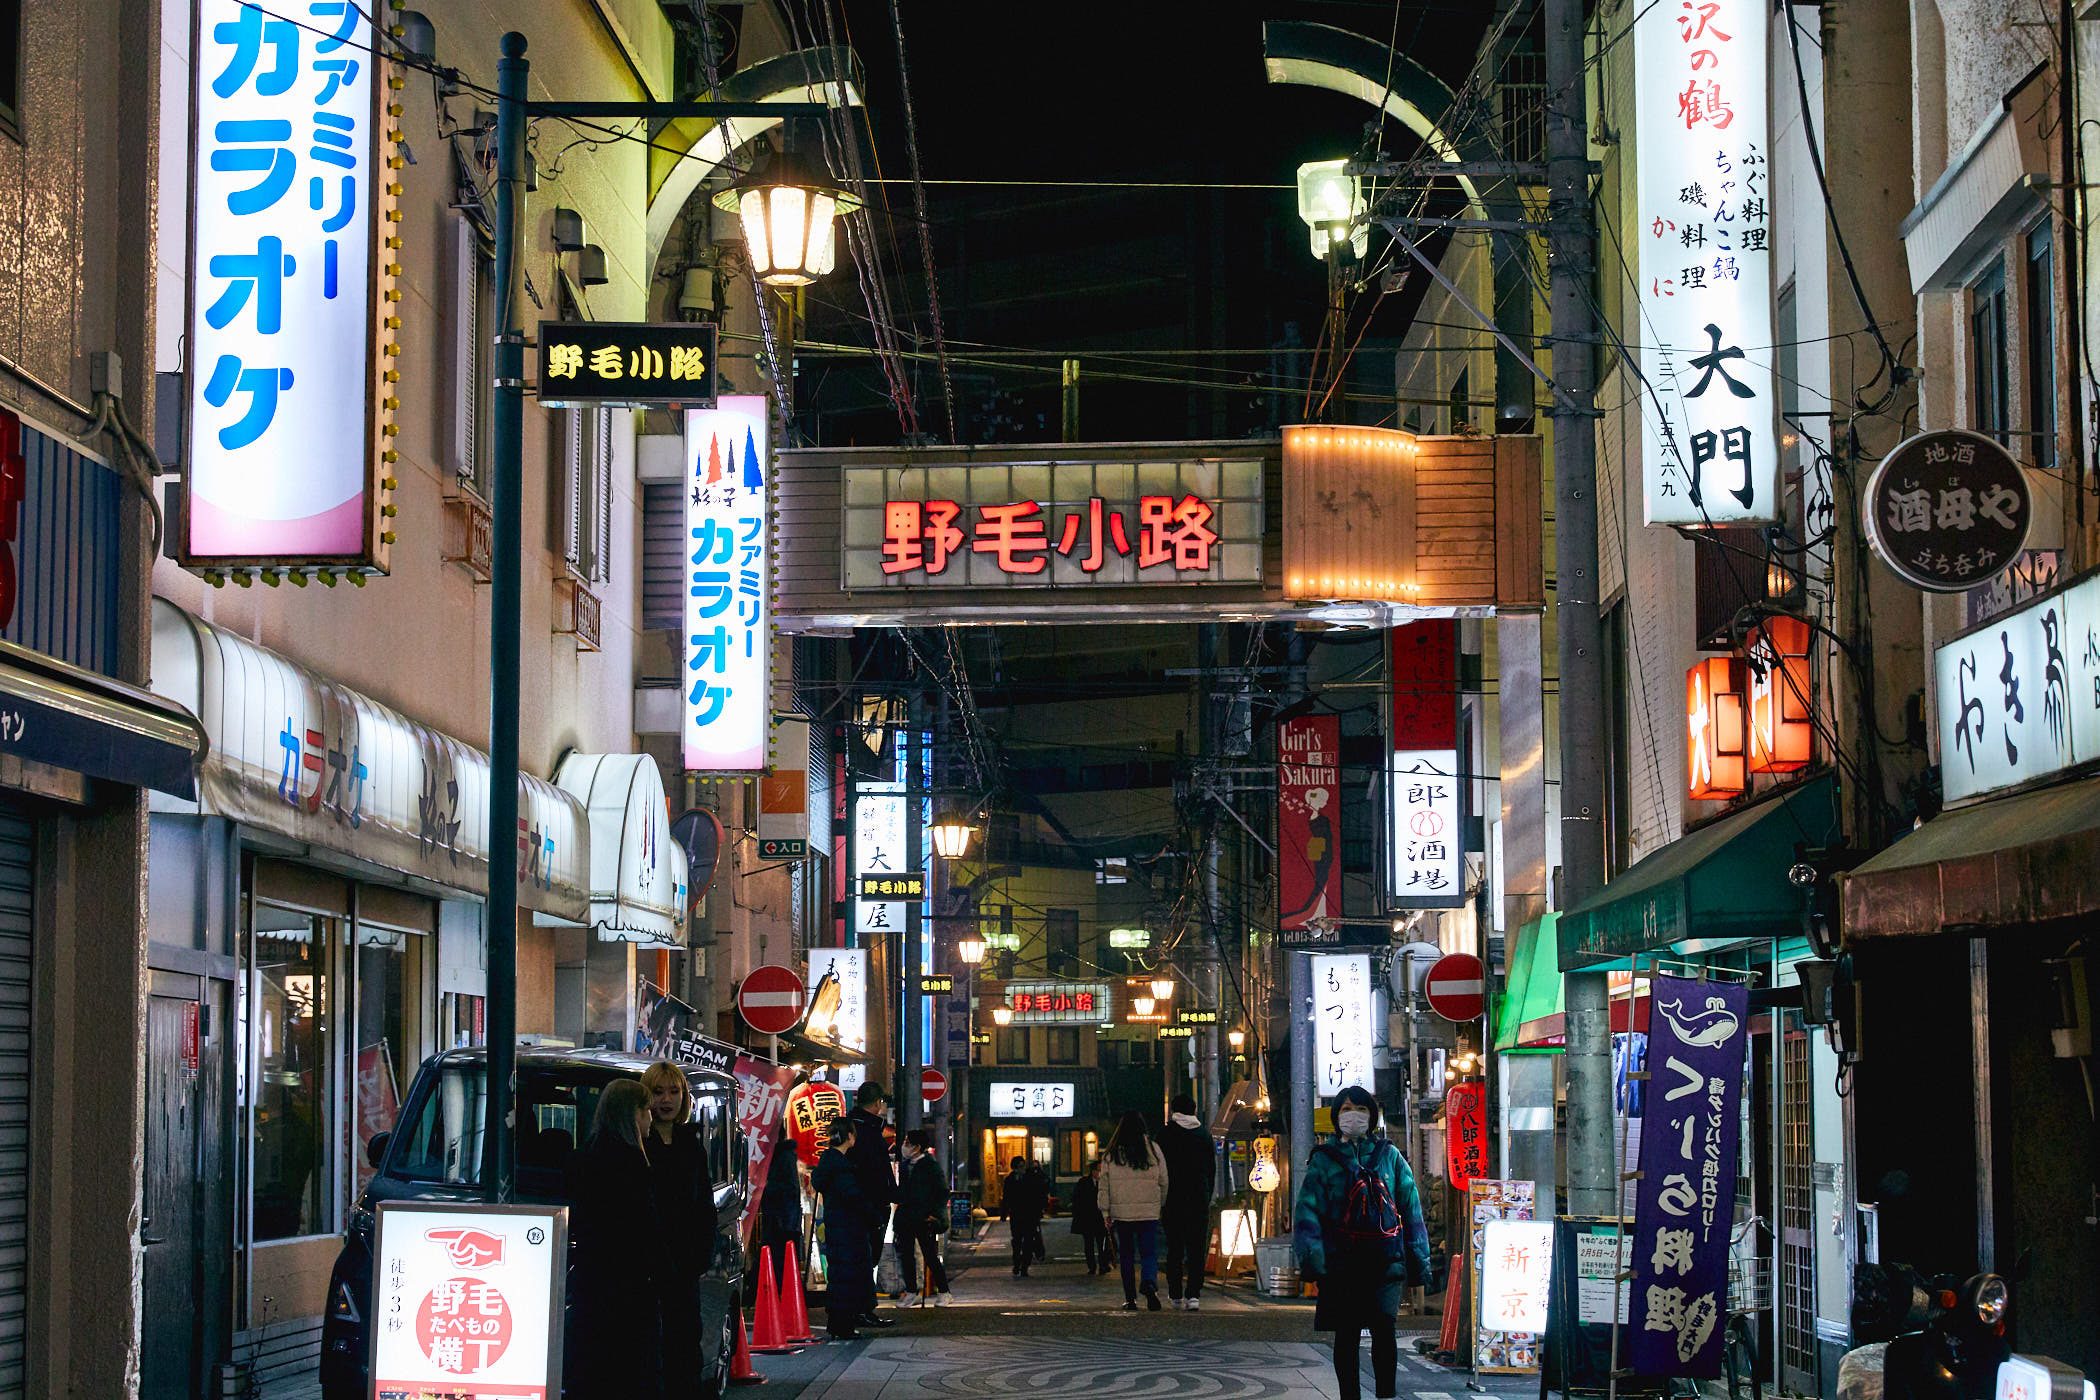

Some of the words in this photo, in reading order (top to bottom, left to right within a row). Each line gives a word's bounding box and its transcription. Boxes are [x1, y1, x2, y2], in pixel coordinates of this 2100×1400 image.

[1677, 1, 1734, 130] 沢の鶴
[309, 1, 360, 300] ファミリー
[203, 3, 300, 451] カラオケ
[1713, 151, 1740, 282] ちゃんこ鍋
[1741, 143, 1768, 252] ふぐ料理
[1652, 216, 1676, 298] かに
[1679, 182, 1708, 289] 磯料理
[548, 343, 706, 381] 野毛小路
[1683, 323, 1757, 510] 大門
[1925, 441, 1976, 465] 地酒
[880, 494, 1219, 576] 野毛小路
[1888, 482, 2021, 533] 酒母や
[738, 517, 762, 658] ファミリー
[1911, 547, 1997, 576] 立ち呑み
[689, 518, 734, 727] カラオケ
[278, 716, 368, 830] カラオケ
[1281, 721, 1321, 752] Girl's
[1281, 754, 1336, 786] Sakura
[518, 816, 555, 893] ラオケ
[779, 842, 801, 854] 入口
[1406, 758, 1450, 890] 八郎酒場
[864, 880, 922, 895] 野毛小路
[921, 980, 952, 991] 毛小路
[1014, 992, 1093, 1012] 野毛小路
[679, 1038, 728, 1067] EDAM
[1325, 967, 1350, 1089] もつしげ
[796, 1100, 813, 1129] 天然
[1460, 1113, 1481, 1178] 八郎酒場
[388, 1258, 405, 1333] 徒歩3秒
[431, 1281, 503, 1316] 野毛
[1502, 1243, 1530, 1319] 新京
[428, 1336, 502, 1373] 横丁
[430, 1317, 500, 1336] たべもの
